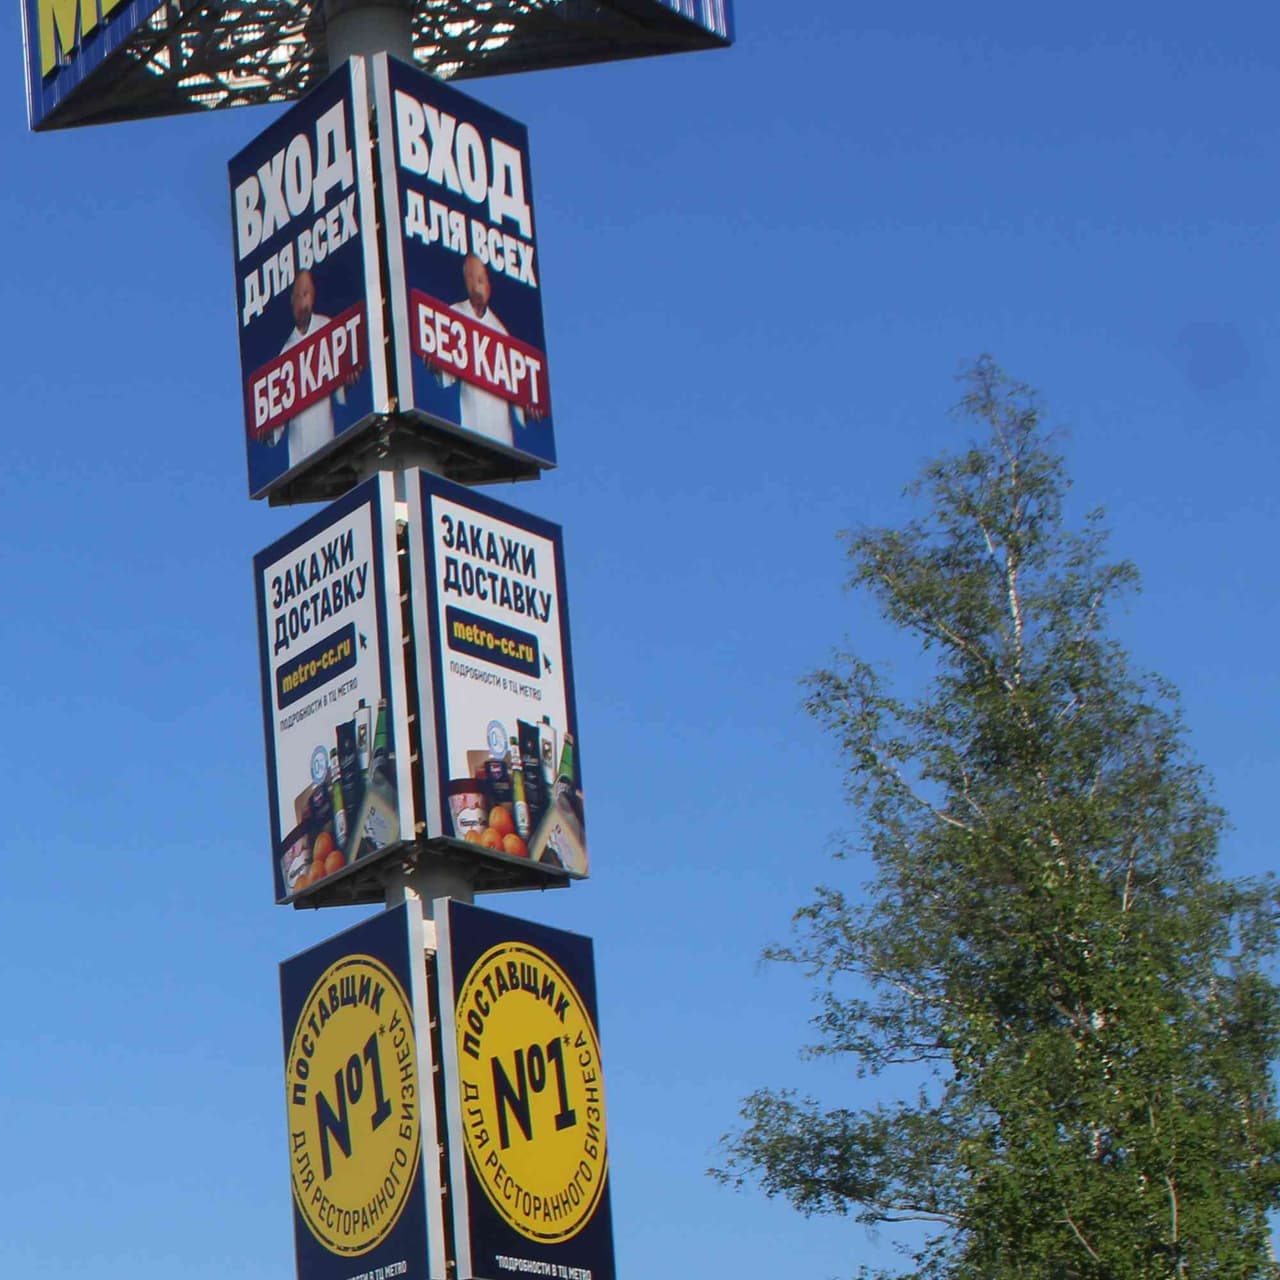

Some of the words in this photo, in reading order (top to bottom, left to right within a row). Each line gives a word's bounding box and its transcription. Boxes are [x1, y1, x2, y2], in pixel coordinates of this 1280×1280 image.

[236, 99, 355, 260] ВХОД
[395, 90, 532, 238] ВХОД
[243, 243, 295, 327] ДЛЯ
[298, 192, 359, 270] ВСЕХ
[405, 193, 468, 256] ДЛЯ
[472, 220, 536, 288] ВСЕХ
[253, 358, 295, 430] БЕЗ
[299, 313, 362, 401] КАРТ
[418, 303, 468, 368] БЕЗ
[473, 332, 541, 405] КАРТ
[272, 528, 354, 610] ЗАКАЖИ
[441, 514, 537, 579] ЗАКАЖИ
[443, 557, 552, 623] ДОСТАВКУ
[274, 562, 368, 656] ДОСТАВКУ
[453, 618, 534, 663] metro-cc.ru
[279, 698, 323, 732] ПОДРОБНОСТИ
[338, 677, 358, 700] METRO
[282, 635, 351, 694] metro-cc.ru
[449, 660, 502, 691] ПОДРОБНОСТИ
[519, 682, 542, 700] METRO
[293, 974, 385, 1106] ПОСТАВЩИК
[463, 961, 570, 1060] ПОСТАВЩИК
[292, 1130, 315, 1187] ДЛЯ
[312, 1152, 408, 1236] РЕСТОРАННОГО
[388, 1009, 415, 1141] БИЗНЕСА
[463, 1080, 489, 1149] ДЛЯ
[485, 1150, 593, 1222] РЕСТОРАННОГО
[575, 1030, 600, 1160] БИЗНЕСА
[385, 1260, 407, 1278] METRO
